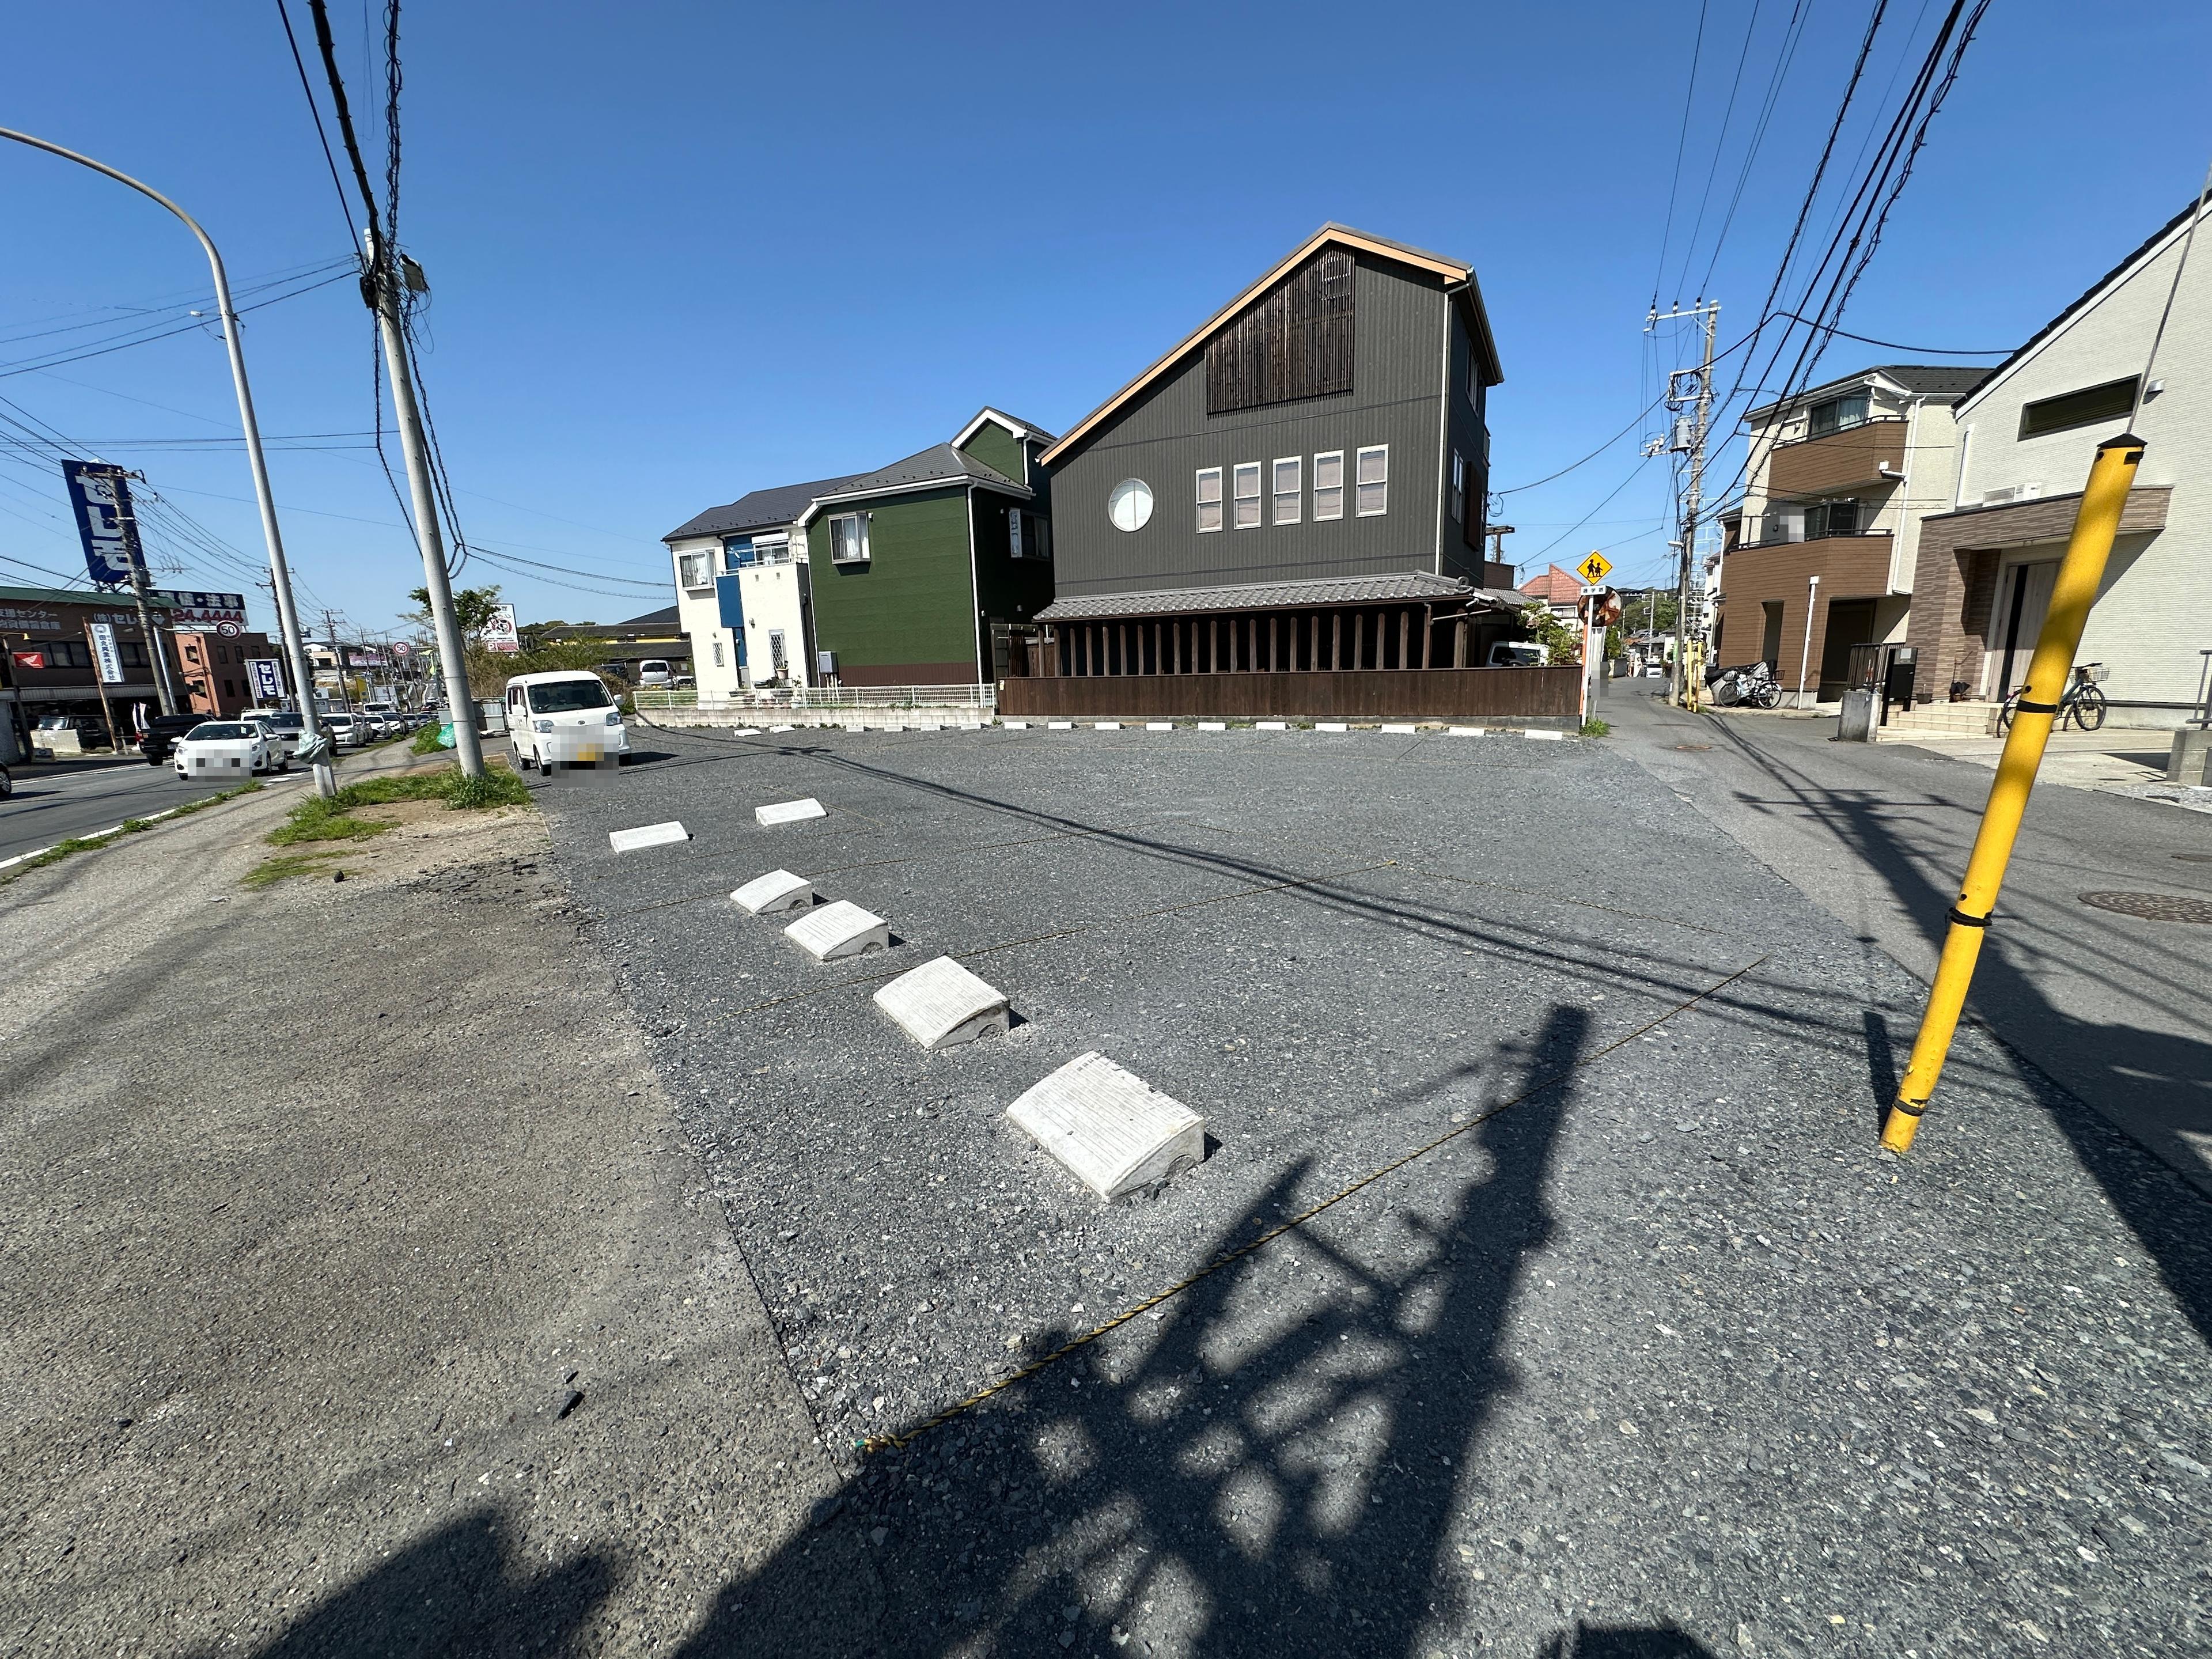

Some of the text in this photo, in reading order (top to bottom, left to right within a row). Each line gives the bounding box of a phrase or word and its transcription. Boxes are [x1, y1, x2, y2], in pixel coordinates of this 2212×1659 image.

[75, 475, 130, 571] セレモ
[93, 613, 141, 624] (株)セレ
[221, 626, 235, 634] 50
[259, 664, 276, 695] セレモ
